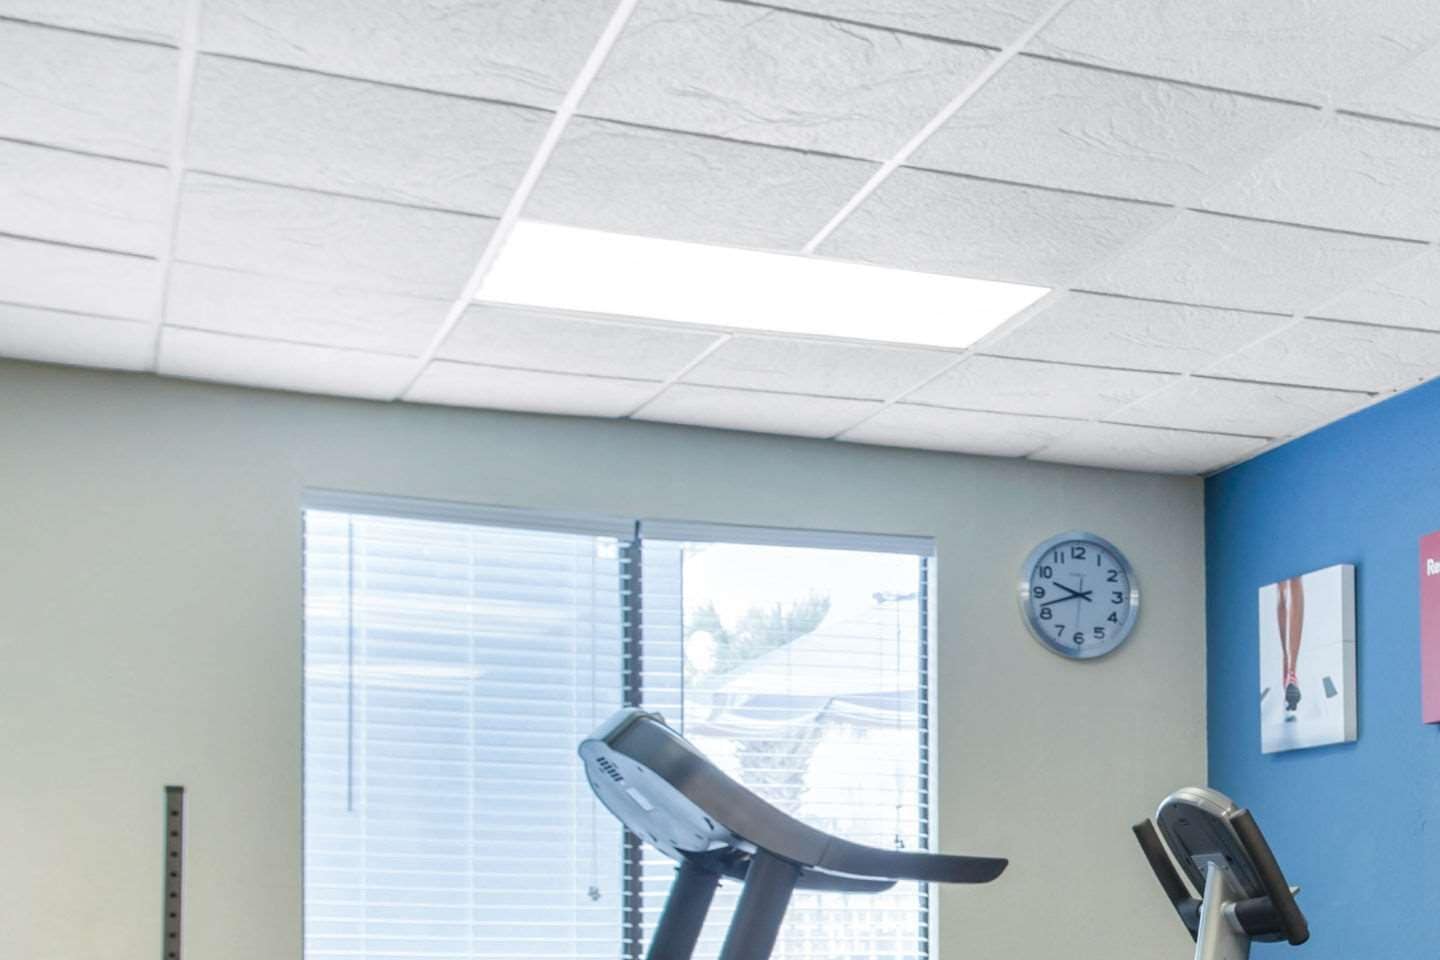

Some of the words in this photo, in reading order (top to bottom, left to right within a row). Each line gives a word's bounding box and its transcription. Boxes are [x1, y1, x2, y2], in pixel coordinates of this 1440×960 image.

[1053, 551, 1065, 564] 11
[1070, 546, 1086, 560] 12
[1096, 554, 1102, 567] 1
[1039, 566, 1053, 579] 10
[1107, 569, 1118, 583] 2
[1033, 586, 1045, 599] 9
[1111, 591, 1123, 604] 3
[1039, 607, 1052, 620] 8
[1107, 611, 1118, 623] 4
[1055, 625, 1066, 637] 7
[1093, 627, 1105, 639] 5
[1073, 632, 1084, 645] 6
